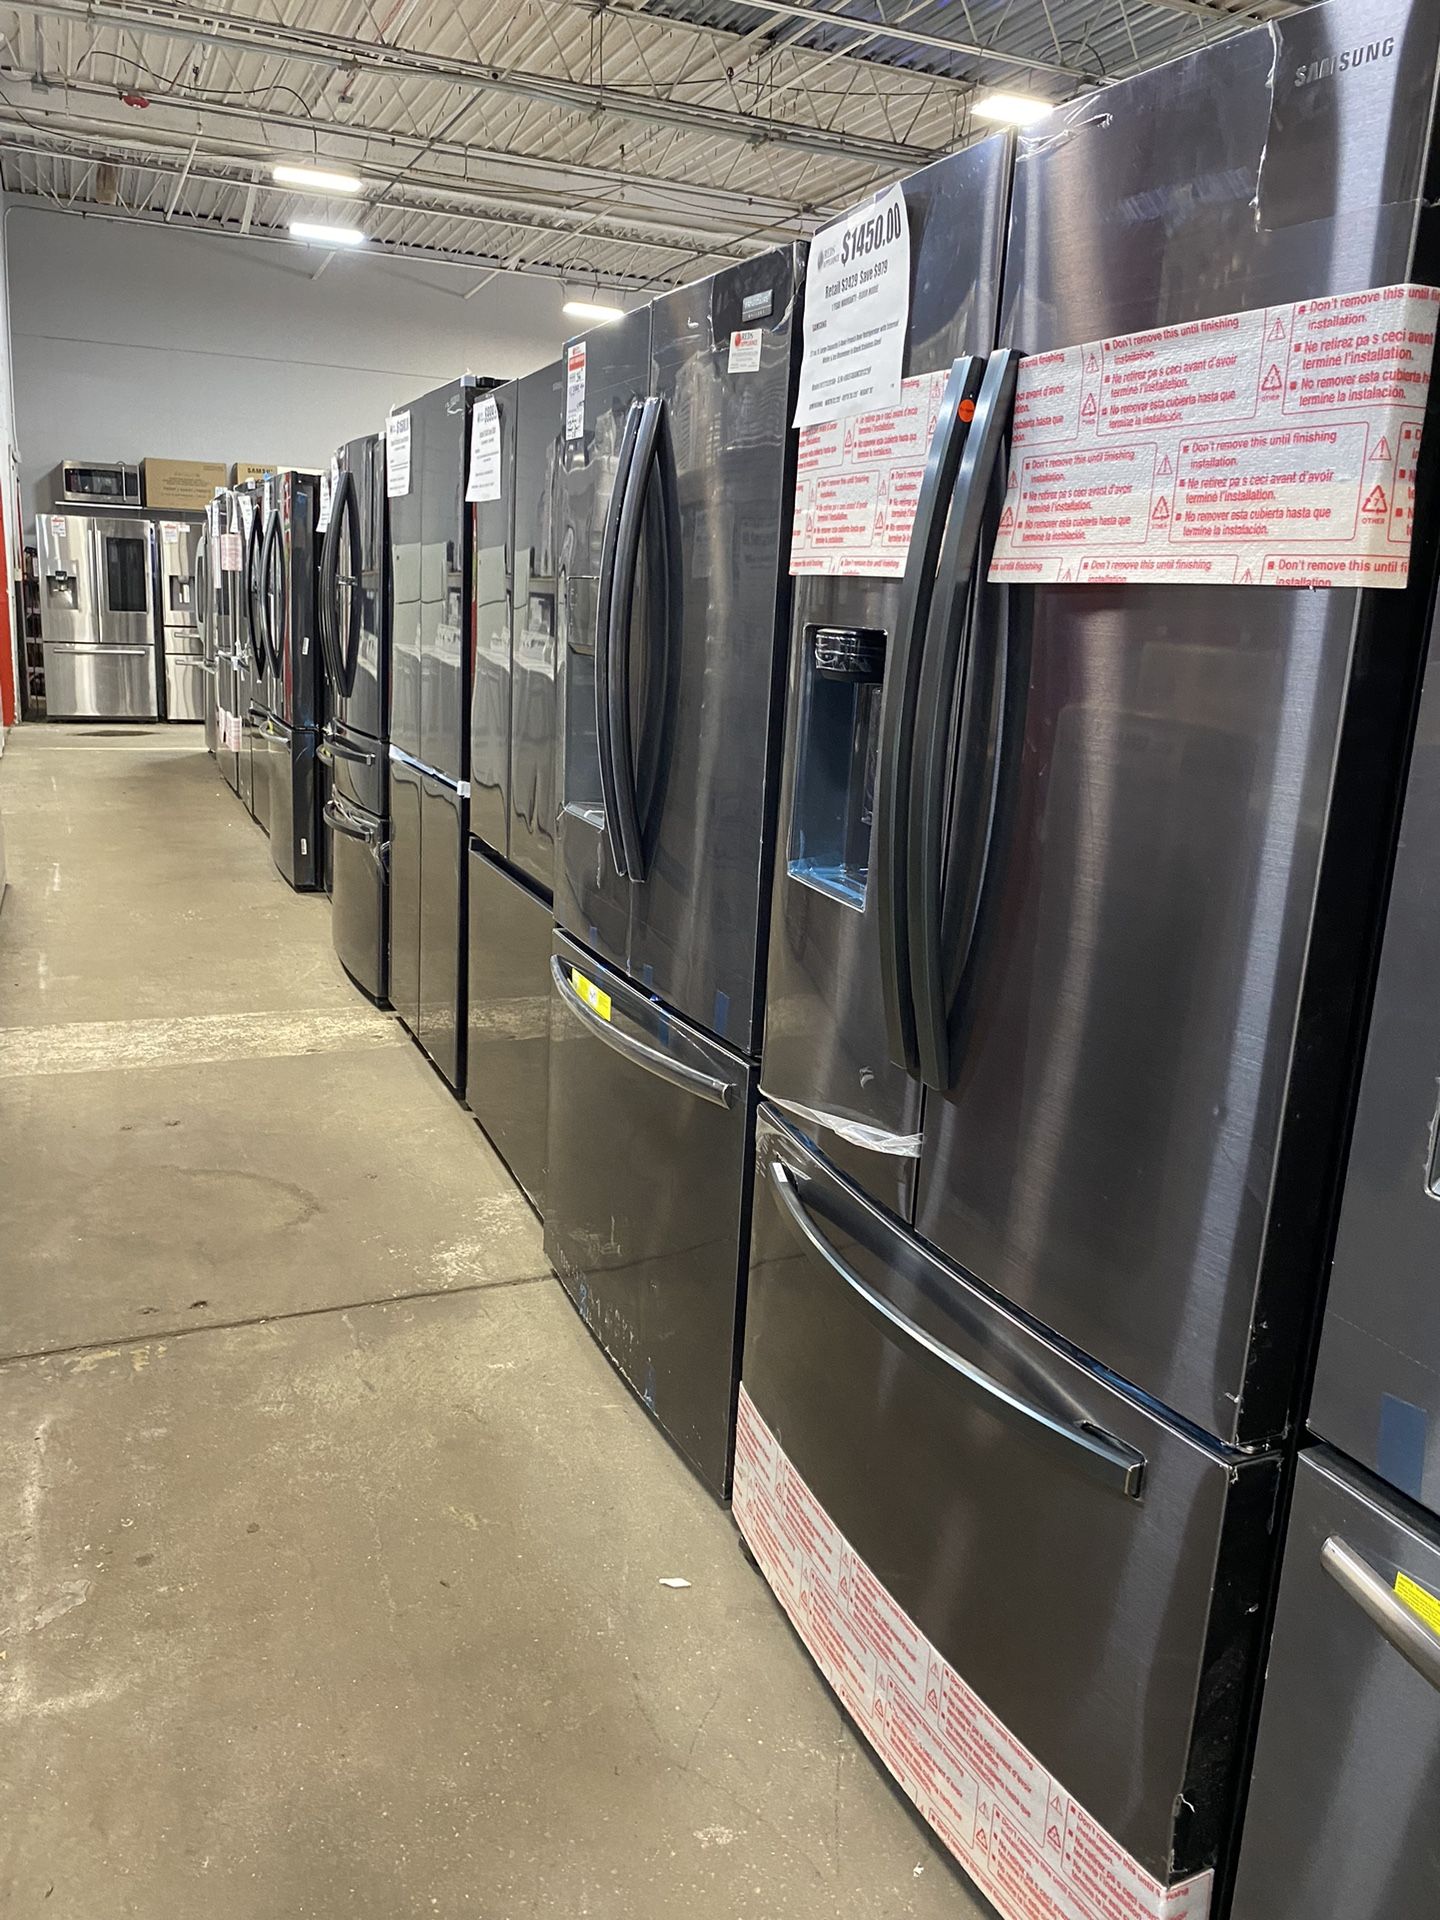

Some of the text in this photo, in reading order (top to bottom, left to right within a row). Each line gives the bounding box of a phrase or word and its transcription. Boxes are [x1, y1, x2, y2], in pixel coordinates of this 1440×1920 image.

[1294, 37, 1394, 88] SAMSUNG
[841, 202, 901, 267] $1450.00
[825, 260, 888, 299] Retail $2429 Save $979
[1310, 298, 1337, 312] Don't
[1340, 292, 1380, 307] remove
[1383, 288, 1403, 300] this
[1408, 288, 1429, 298] until
[1112, 317, 1239, 349] Don't remove this until finishing
[1304, 340, 1318, 353] Ne
[1321, 337, 1353, 351] retirez
[1356, 335, 1370, 349] pa
[1383, 328, 1405, 342] ceci
[1344, 350, 1414, 364] l'installation.
[1301, 377, 1314, 390] No
[1317, 374, 1355, 388] remover
[1359, 371, 1379, 383] esta
[1383, 368, 1420, 383] cubierta
[1299, 393, 1335, 406] termine
[1337, 389, 1346, 401] la
[1192, 431, 1337, 453] Don't remove this until finishing
[1187, 478, 1199, 489] Ne
[1201, 476, 1226, 488] retirez
[1229, 476, 1240, 487] pa
[1250, 472, 1268, 485] ceci
[1298, 469, 1334, 482] d'avoir
[1185, 506, 1331, 522] No remover esta cubierta hasta que
[1278, 560, 1306, 570] Don't
[1307, 561, 1345, 570] remove
[1349, 560, 1370, 571] this
[1374, 562, 1397, 572] until
